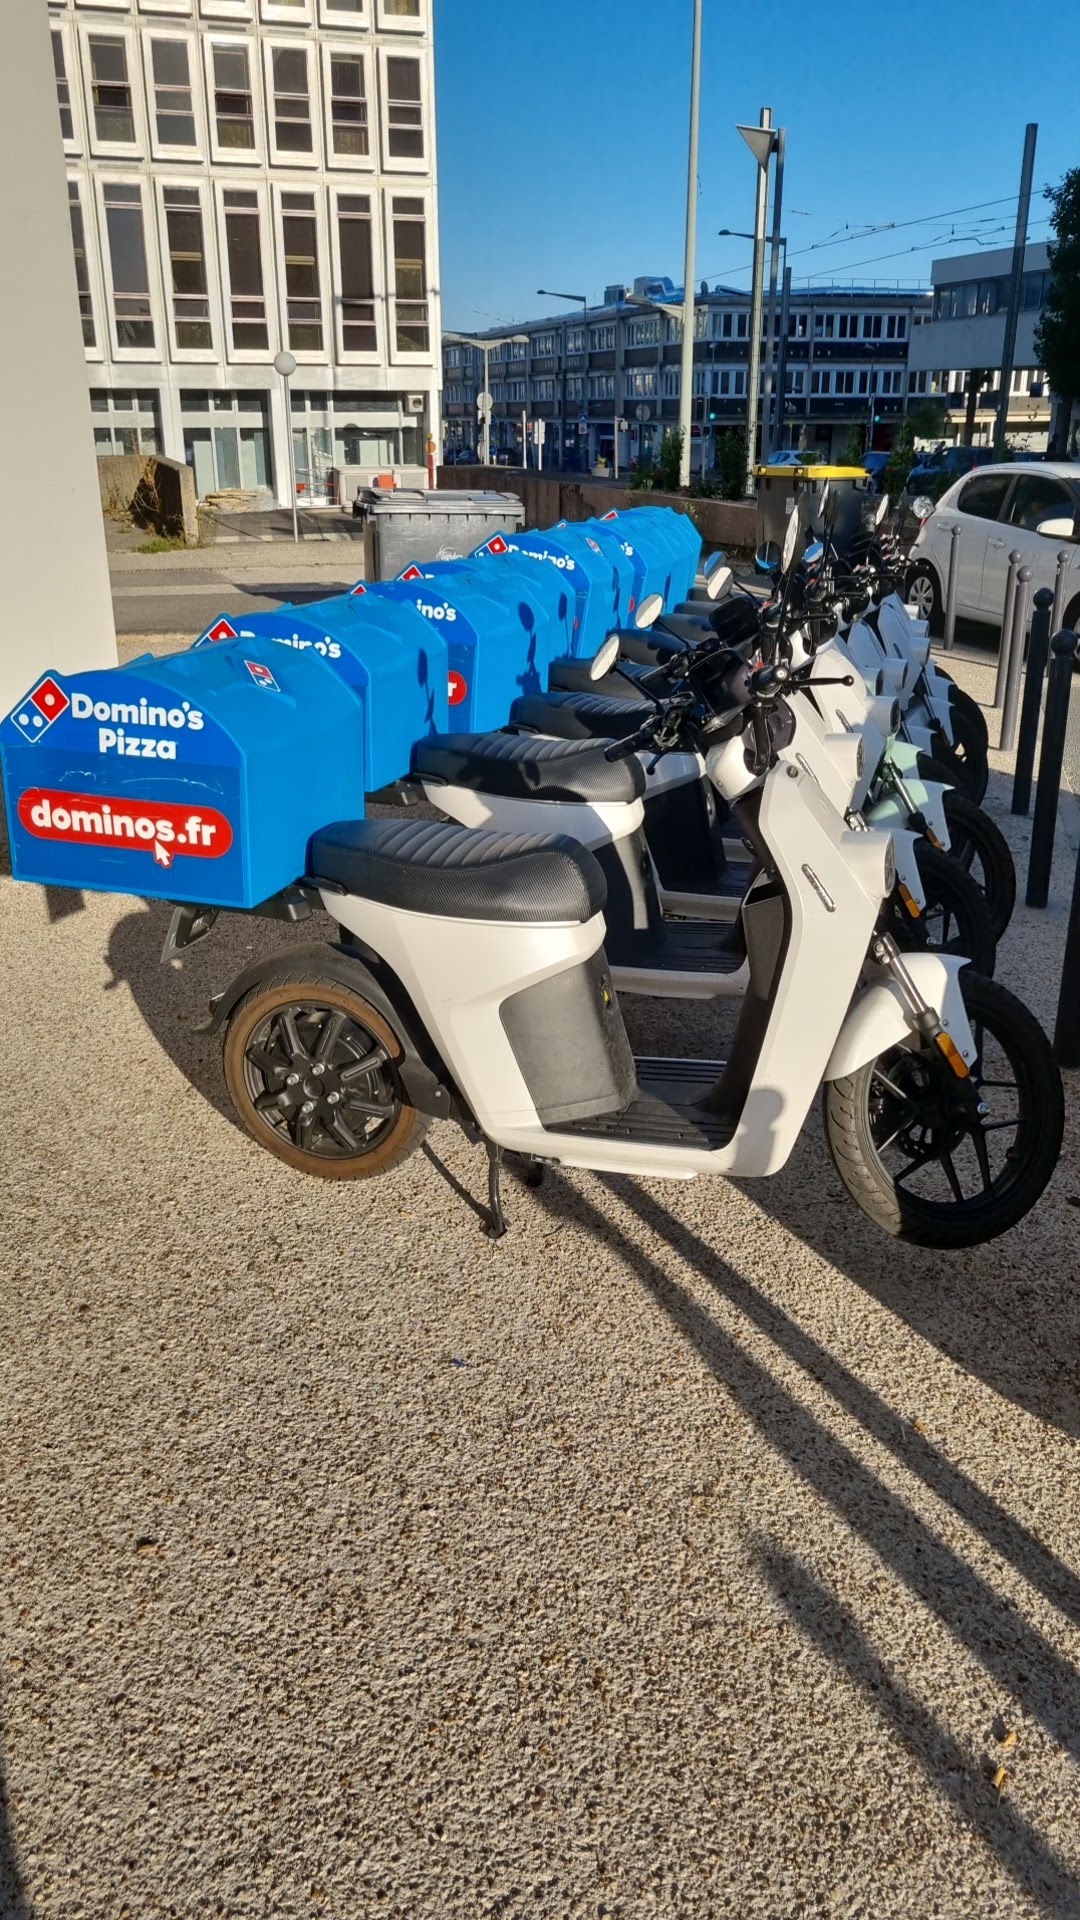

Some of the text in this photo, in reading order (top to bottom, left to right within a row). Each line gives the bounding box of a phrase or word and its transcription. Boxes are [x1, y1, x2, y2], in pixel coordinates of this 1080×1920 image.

[71, 693, 204, 731] Domino's
[98, 728, 177, 760] Pizza
[30, 799, 216, 846] dominos.fr
